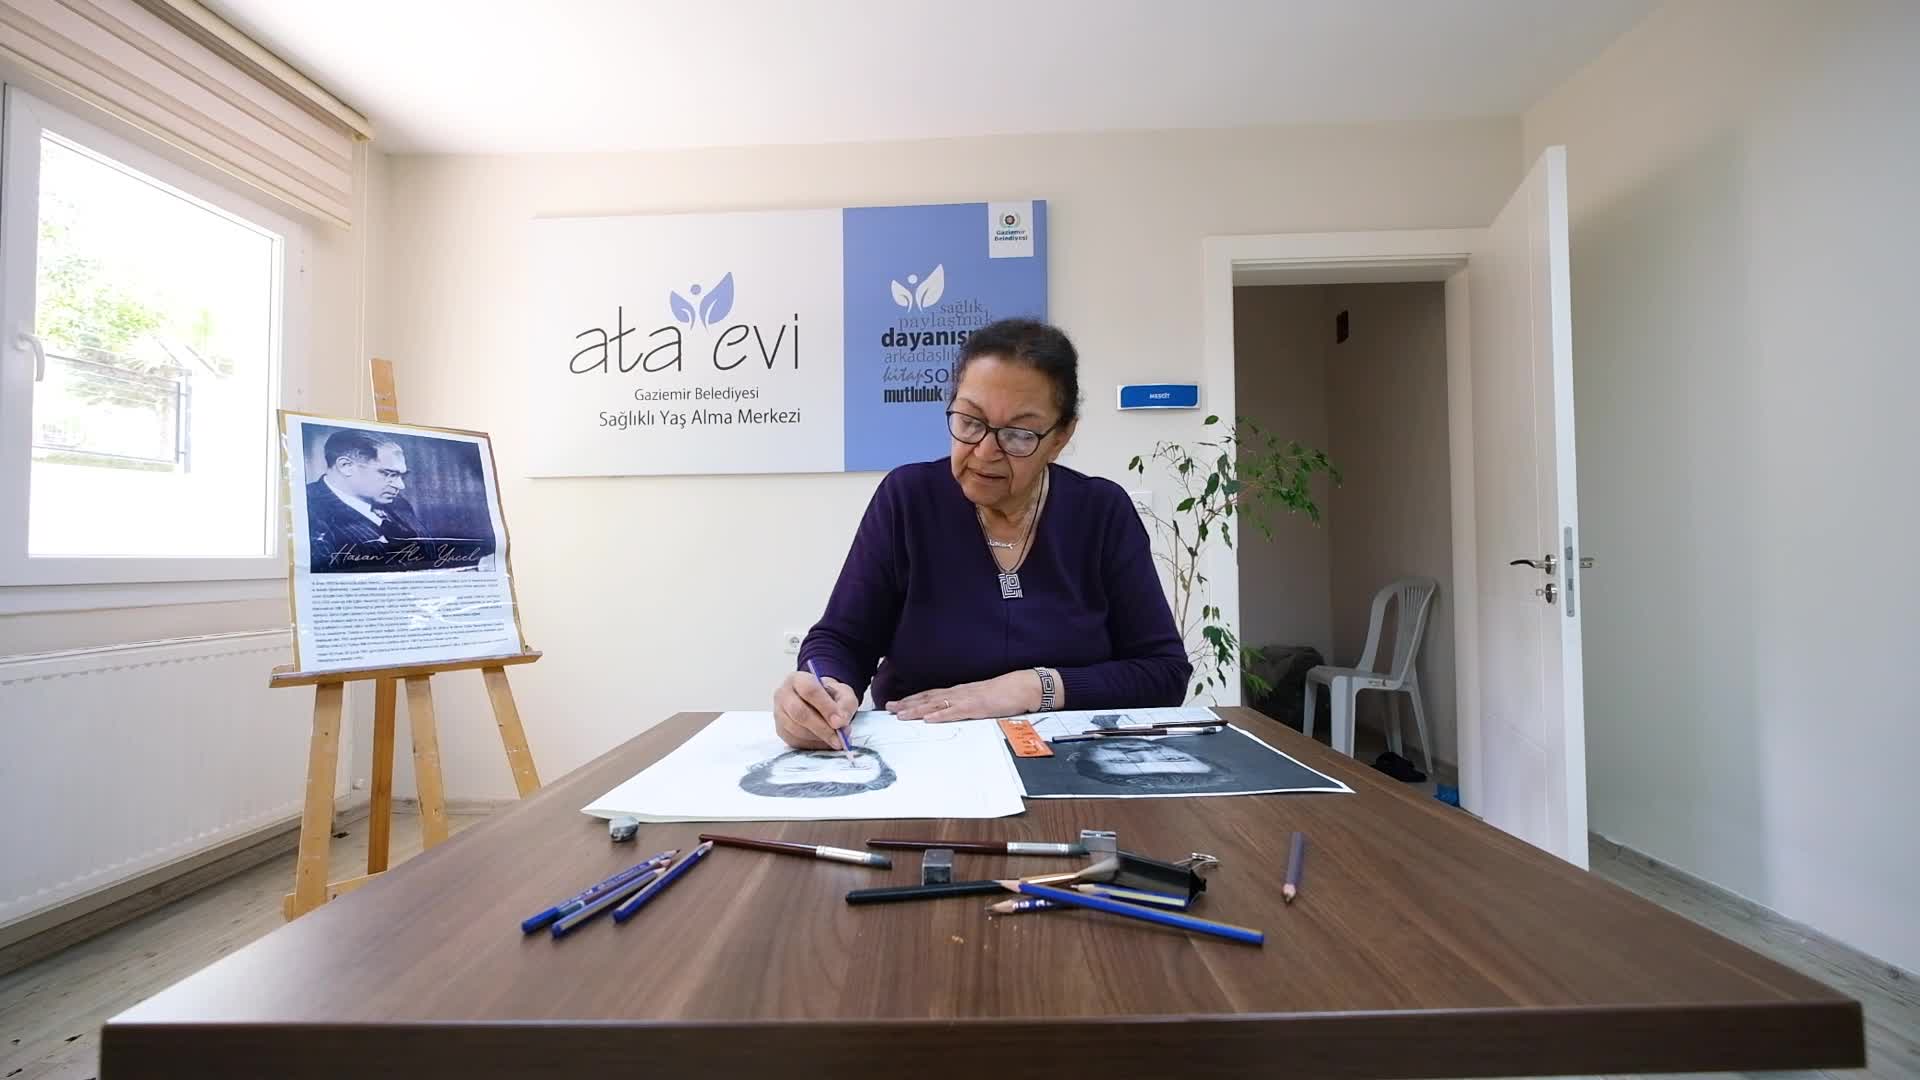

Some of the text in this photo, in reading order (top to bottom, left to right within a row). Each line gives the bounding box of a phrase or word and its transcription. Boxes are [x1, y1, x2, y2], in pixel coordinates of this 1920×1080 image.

[940, 299, 983, 318] sağlık
[569, 306, 799, 374] ata evi
[881, 327, 974, 351] dayanış
[883, 366, 925, 387] kitap
[634, 385, 759, 402] Gaziemir Belediyesi
[884, 385, 943, 403] mutluluk
[599, 407, 801, 430] Sağlıklı Yaş Alma Merkezi
[329, 543, 385, 567] Hasan
[385, 541, 425, 566] Ali
